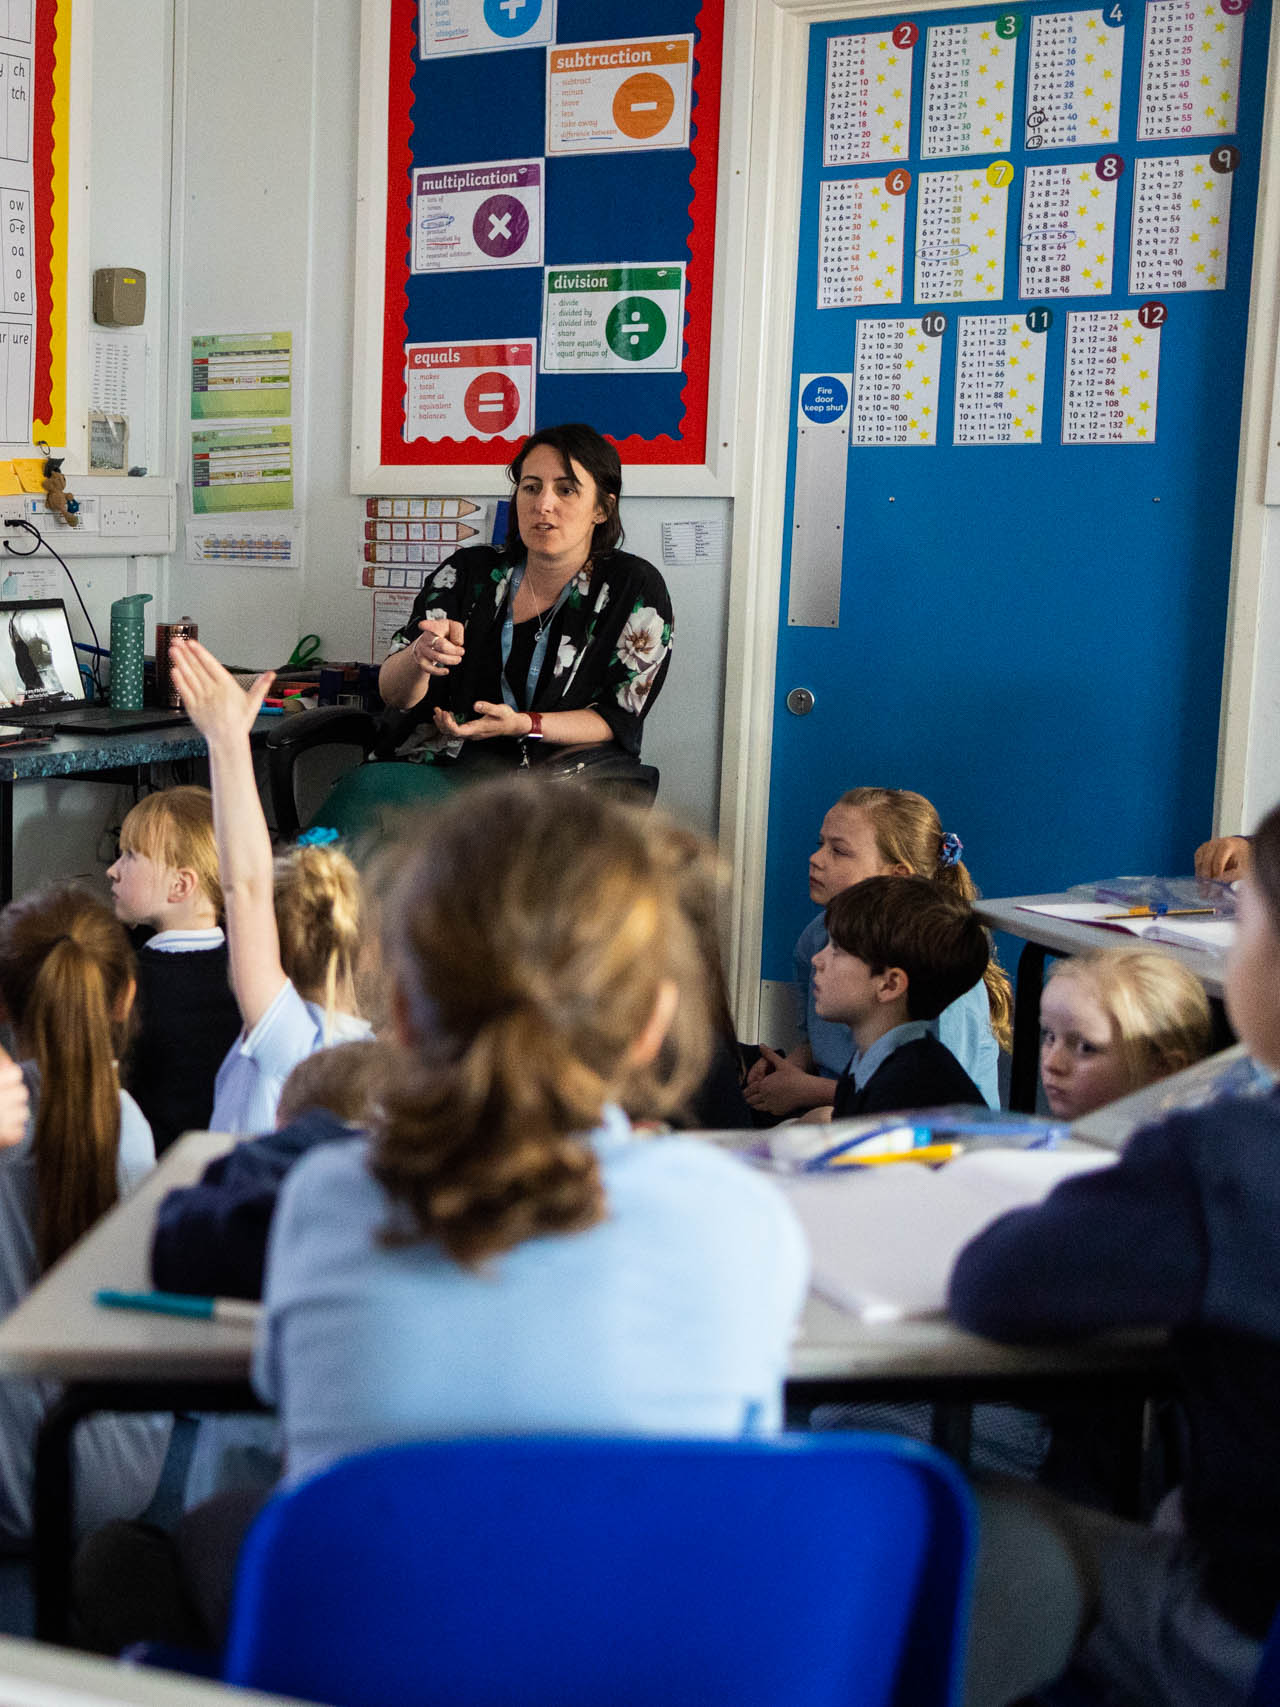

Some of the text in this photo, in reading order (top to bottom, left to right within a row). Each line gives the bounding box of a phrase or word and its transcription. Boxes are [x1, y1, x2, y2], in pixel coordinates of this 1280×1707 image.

[1110, 4, 1123, 21] 4
[1003, 16, 1015, 34] 3
[900, 26, 911, 45] 2
[556, 49, 652, 70] subtraction
[14, 62, 25, 78] ch
[562, 77, 591, 85] subtract
[11, 86, 26, 101] tch
[561, 120, 598, 128] take away
[1145, 127, 1154, 135] 12
[1181, 125, 1192, 133] 60
[561, 128, 617, 138] difference between
[1218, 150, 1231, 168] 9
[1103, 158, 1117, 176] 8
[995, 167, 1007, 185] 7
[422, 172, 518, 193] multiplication
[893, 174, 904, 191] 6
[10, 200, 24, 211] ow
[12, 246, 24, 257] oa
[554, 276, 608, 288] division
[14, 291, 25, 302] oe
[1026, 287, 1034, 295] 12
[559, 299, 579, 307] divide
[584, 309, 592, 317] by
[1142, 307, 1163, 323] 12
[558, 319, 582, 327] divided
[924, 317, 945, 332] 10
[1028, 312, 1048, 328] 11
[13, 333, 29, 345] ure
[577, 339, 602, 349] equally
[414, 348, 460, 368] equals
[556, 348, 608, 359] equal groups of
[419, 402, 451, 411] equivalent
[804, 403, 844, 413] keep shut
